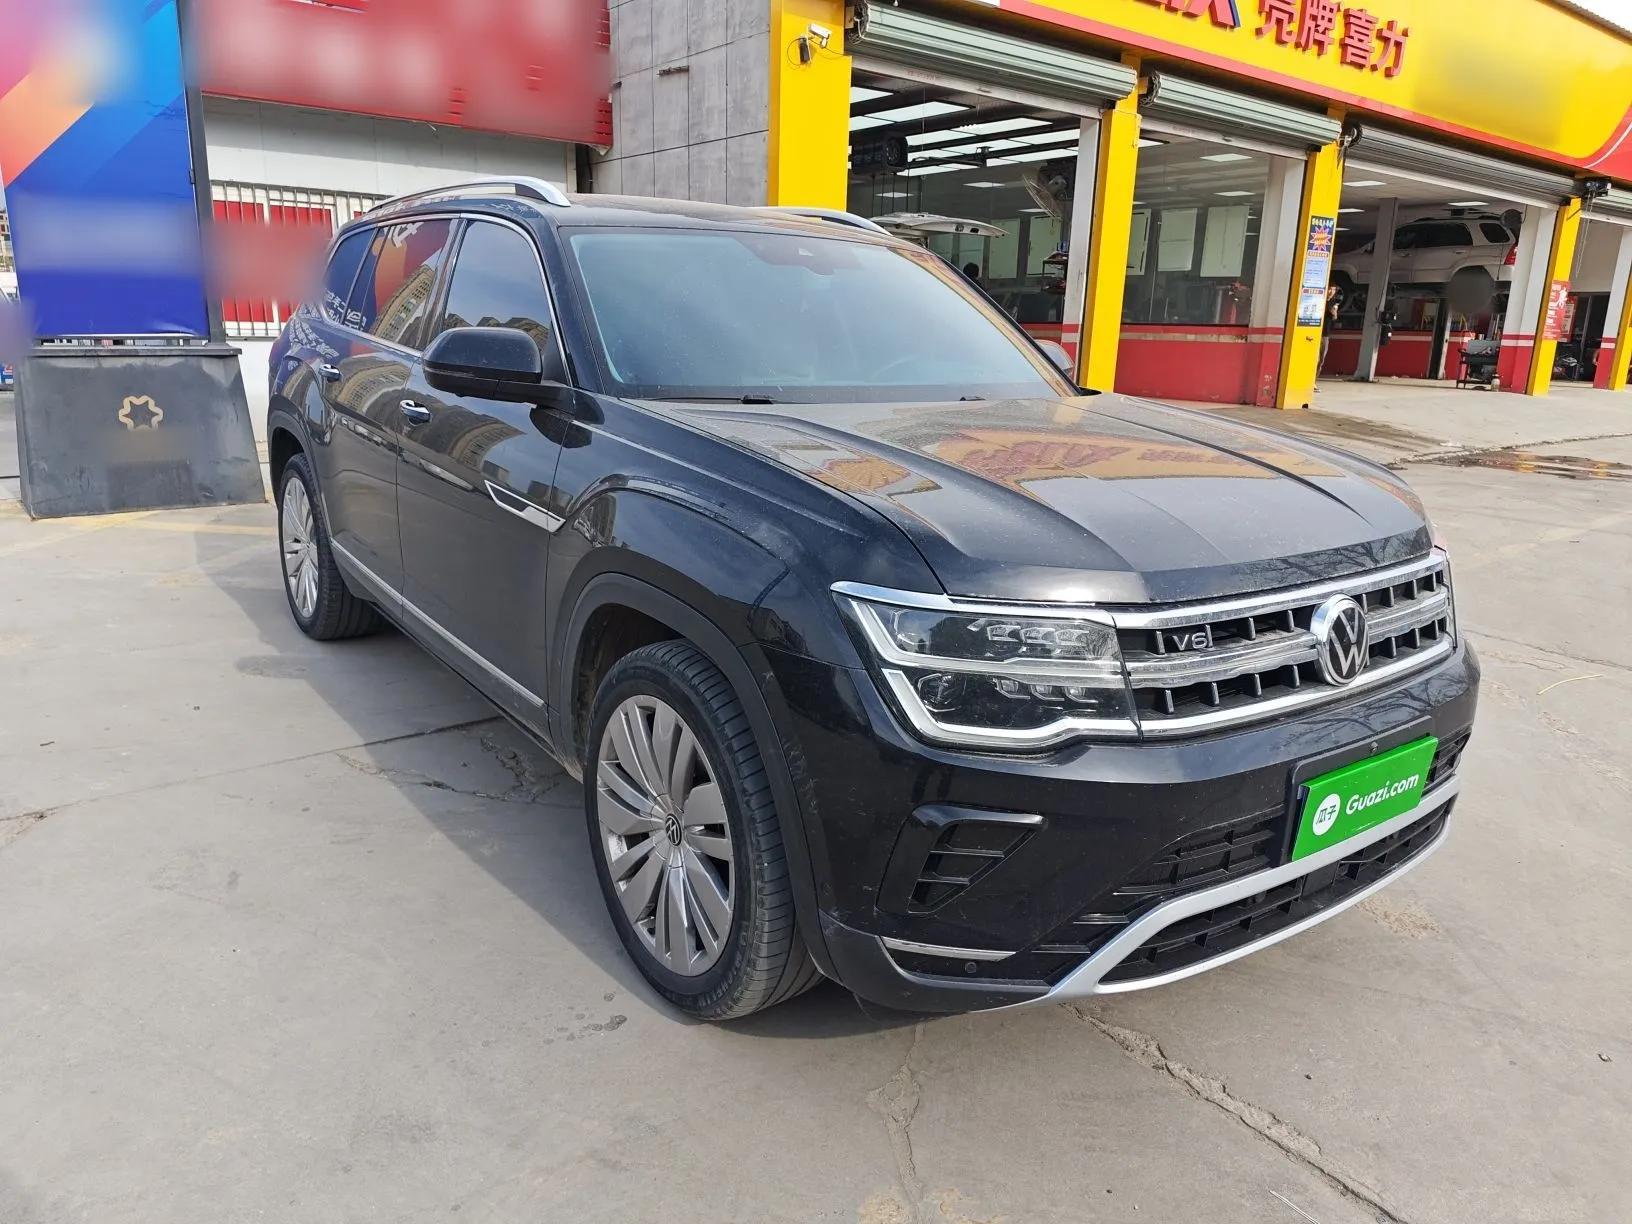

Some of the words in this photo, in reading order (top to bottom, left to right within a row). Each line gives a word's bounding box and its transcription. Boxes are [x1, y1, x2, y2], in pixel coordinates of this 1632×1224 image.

[1173, 631, 1207, 651] V6
[1315, 804, 1337, 825] 瓜子
[1346, 774, 1420, 815] Guazi.com
